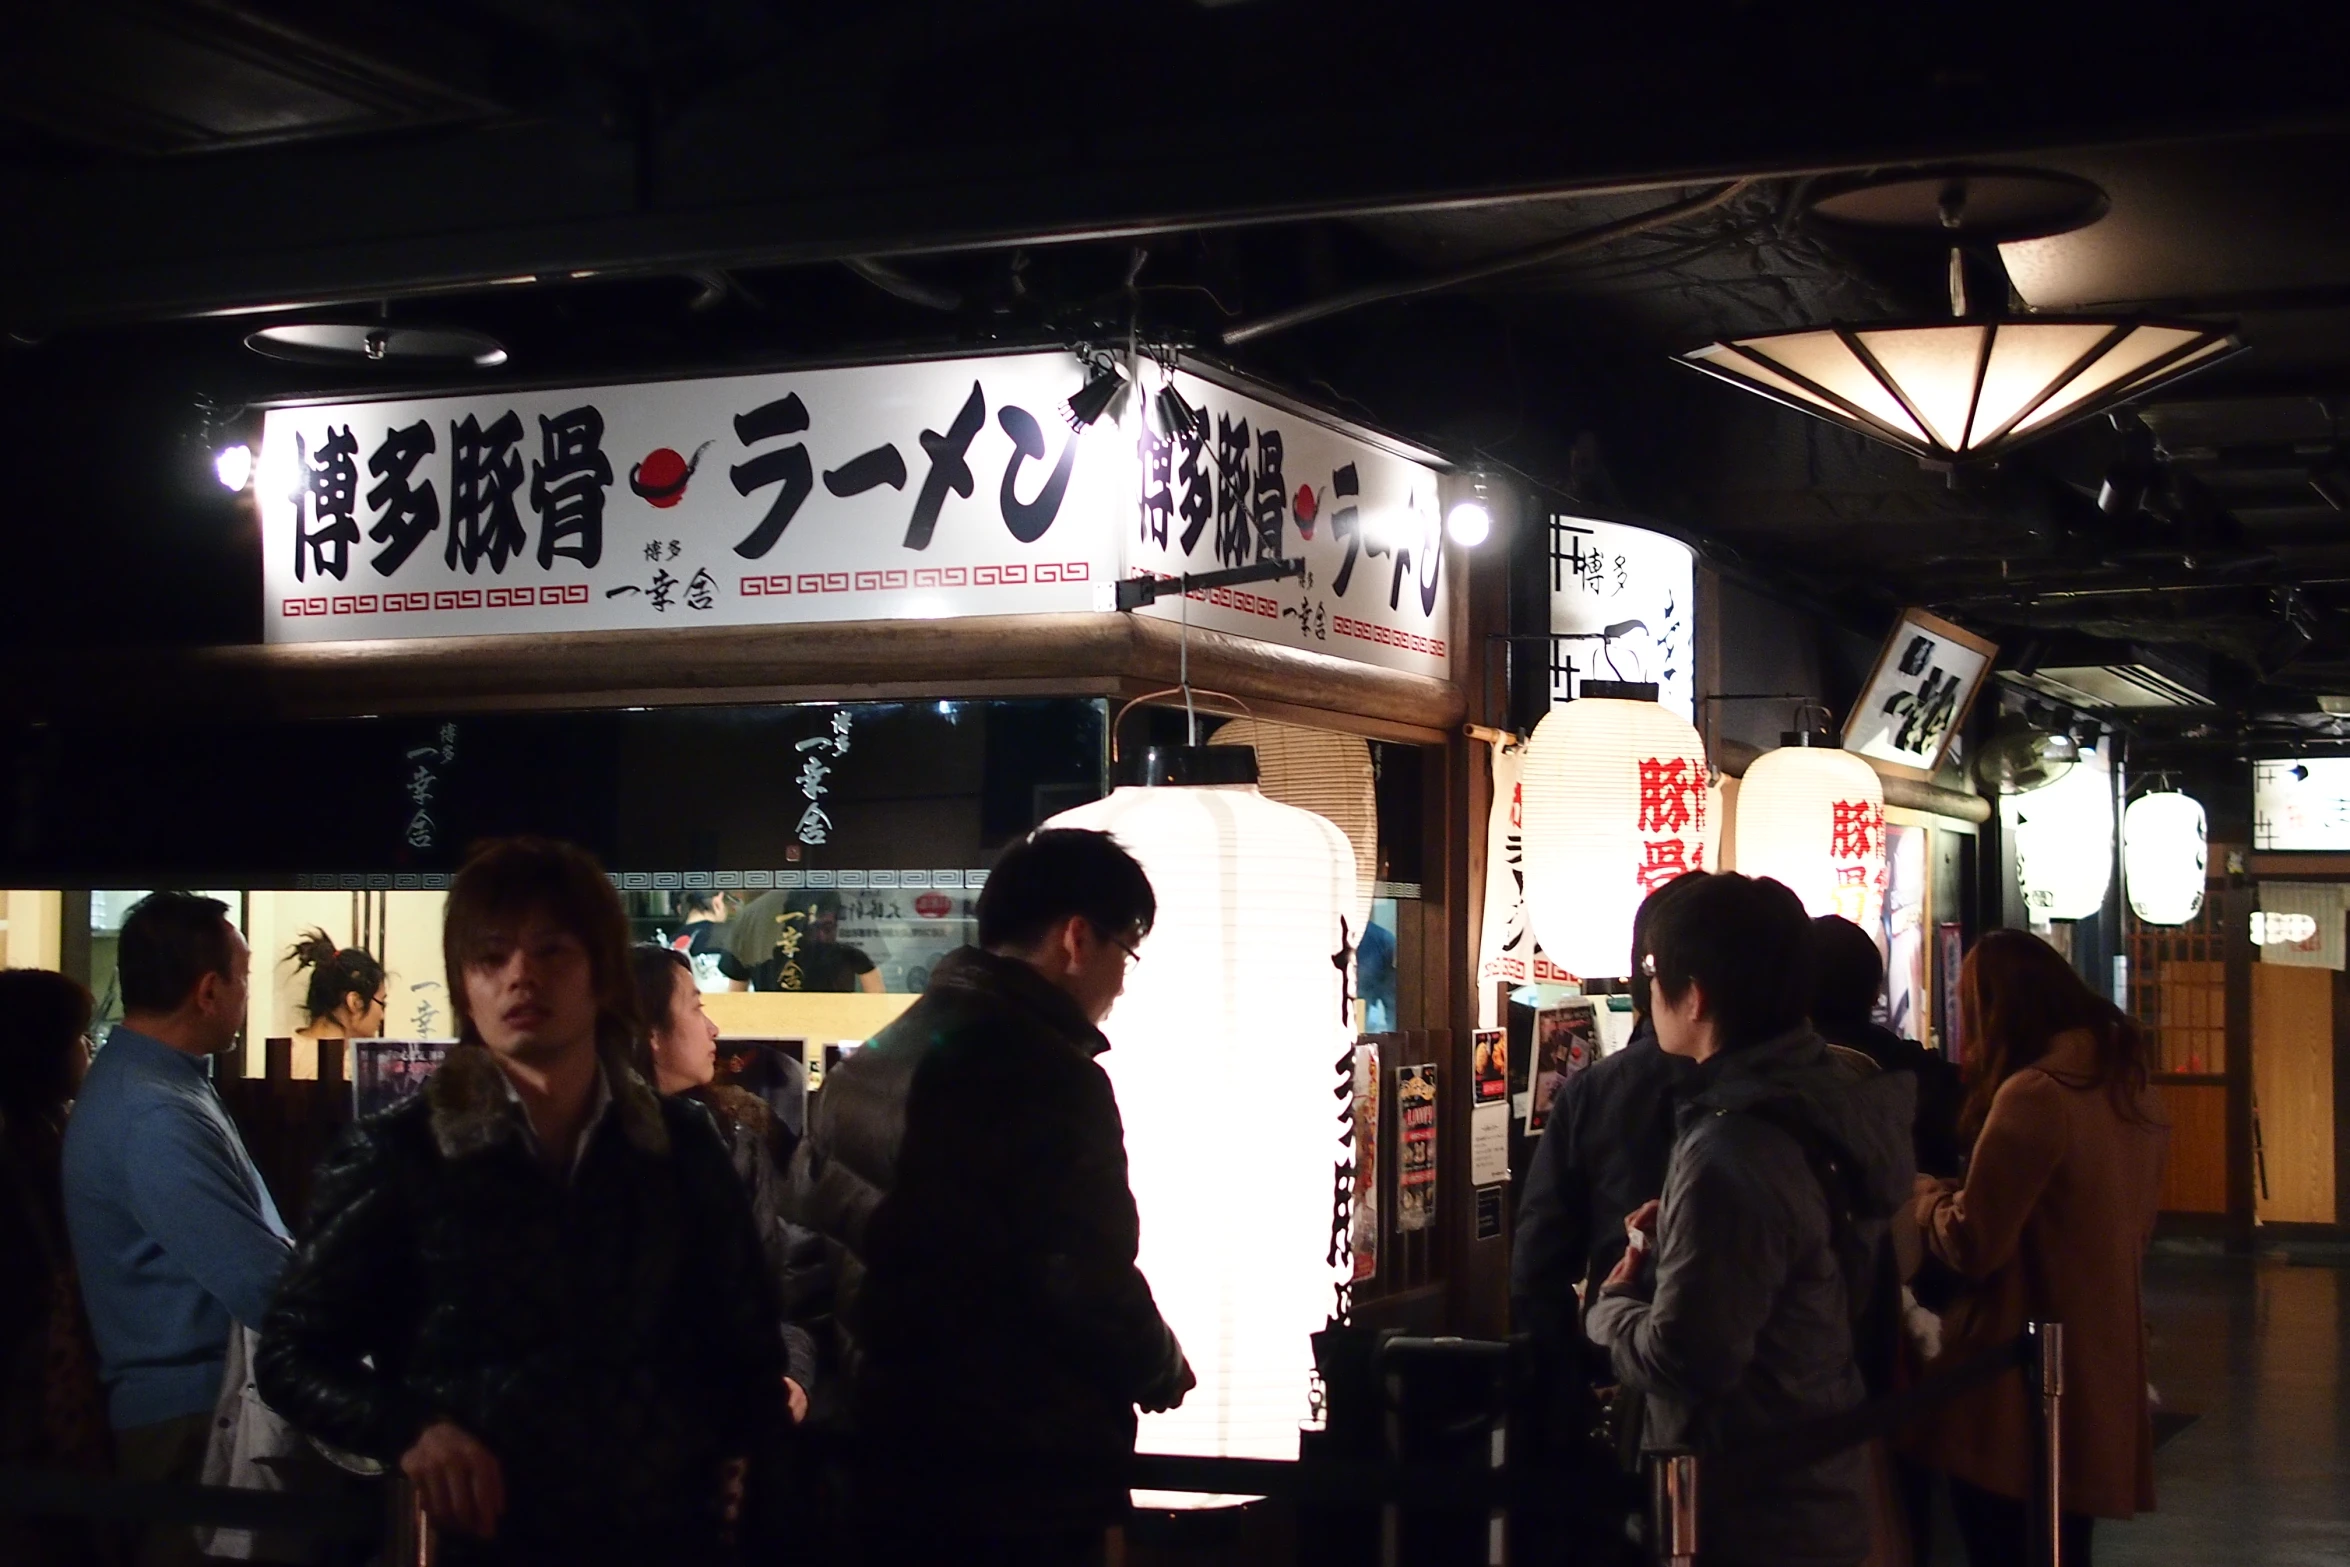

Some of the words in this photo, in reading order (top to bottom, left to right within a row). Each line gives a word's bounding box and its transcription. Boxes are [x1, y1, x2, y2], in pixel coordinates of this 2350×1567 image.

[289, 405, 614, 583] 博多豚骨
[730, 379, 1078, 559] ラーメン
[644, 540, 682, 562] 博多
[1580, 547, 1628, 597] 博多
[605, 567, 720, 612] 一幸舎
[406, 747, 438, 847] 一幸舎
[795, 737, 833, 844] 一幸舎
